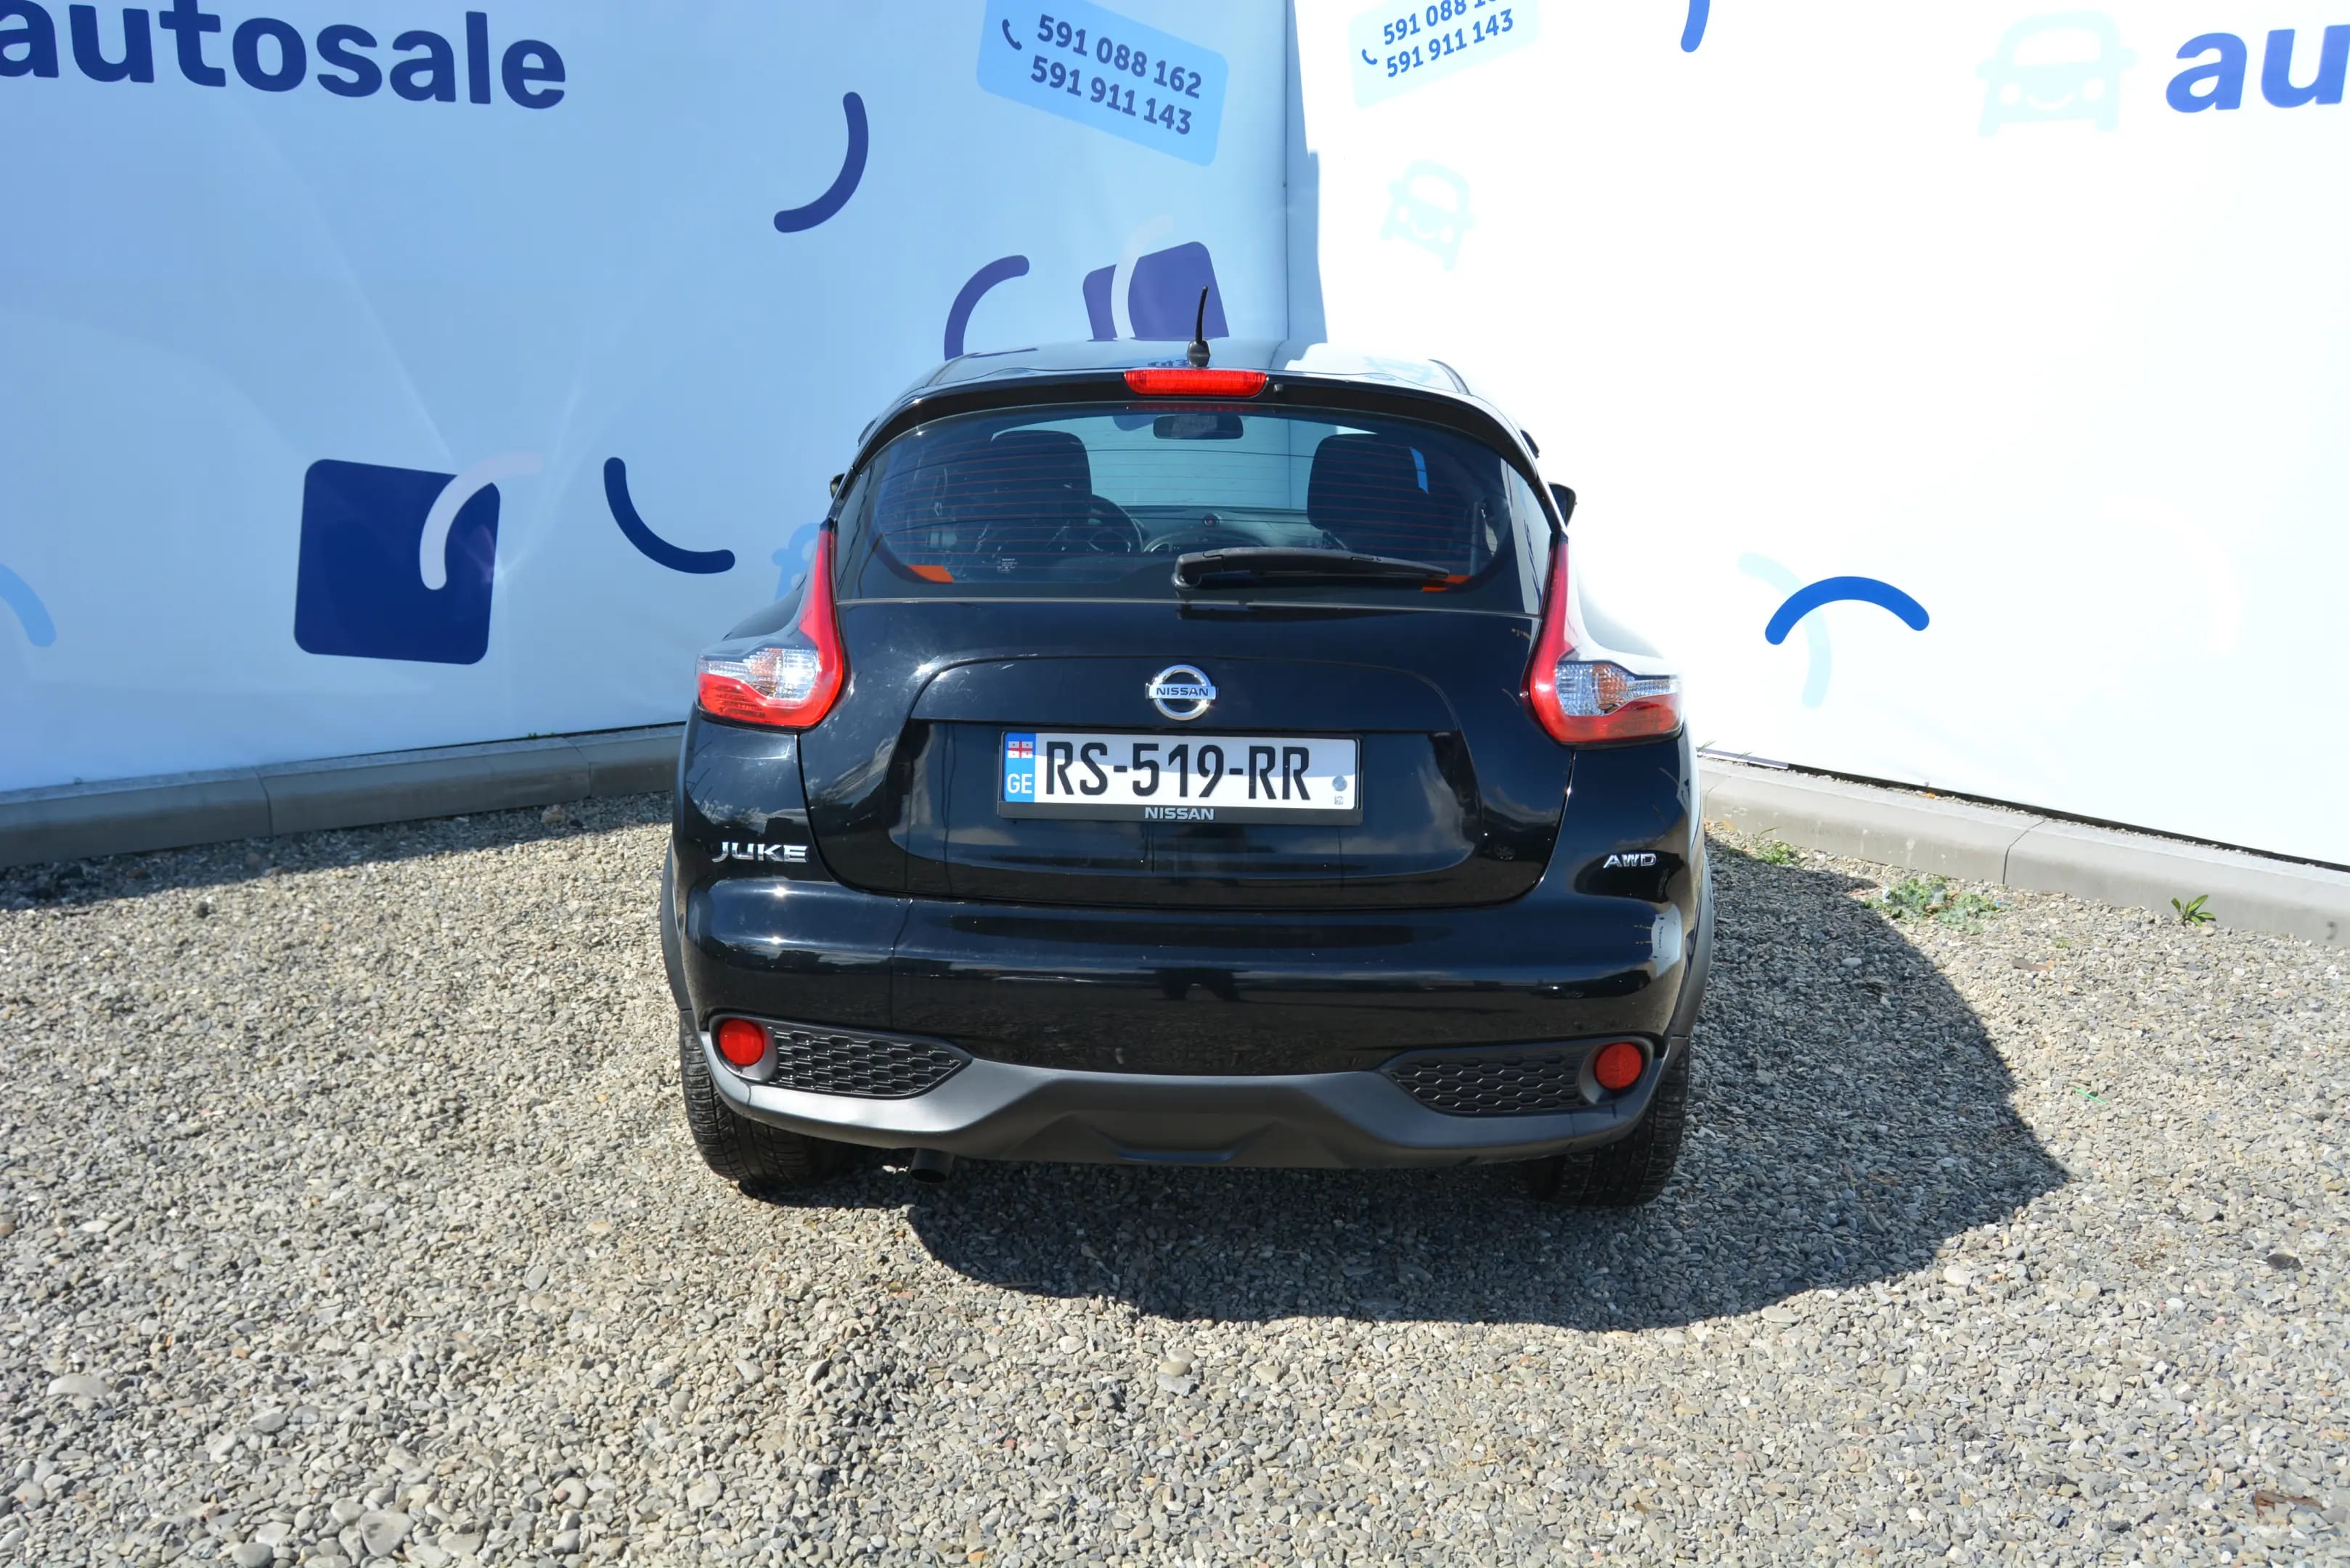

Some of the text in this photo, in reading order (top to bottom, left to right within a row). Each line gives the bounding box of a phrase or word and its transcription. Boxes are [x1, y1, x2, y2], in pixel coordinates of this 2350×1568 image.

[1384, 0, 1466, 45] 591 088
[1387, 8, 1514, 78] 591 911 143
[0, 0, 566, 110] autosale
[1037, 14, 1201, 99] 591 088 162
[1031, 54, 1192, 135] 591 911 143
[1156, 687, 1209, 697] NISSAN
[1007, 773, 1033, 794] GE
[1045, 740, 1311, 801] RS-519-RR
[1144, 807, 1215, 820] NISSAN
[711, 841, 808, 863] JUKE
[1603, 853, 1657, 869] AWD
